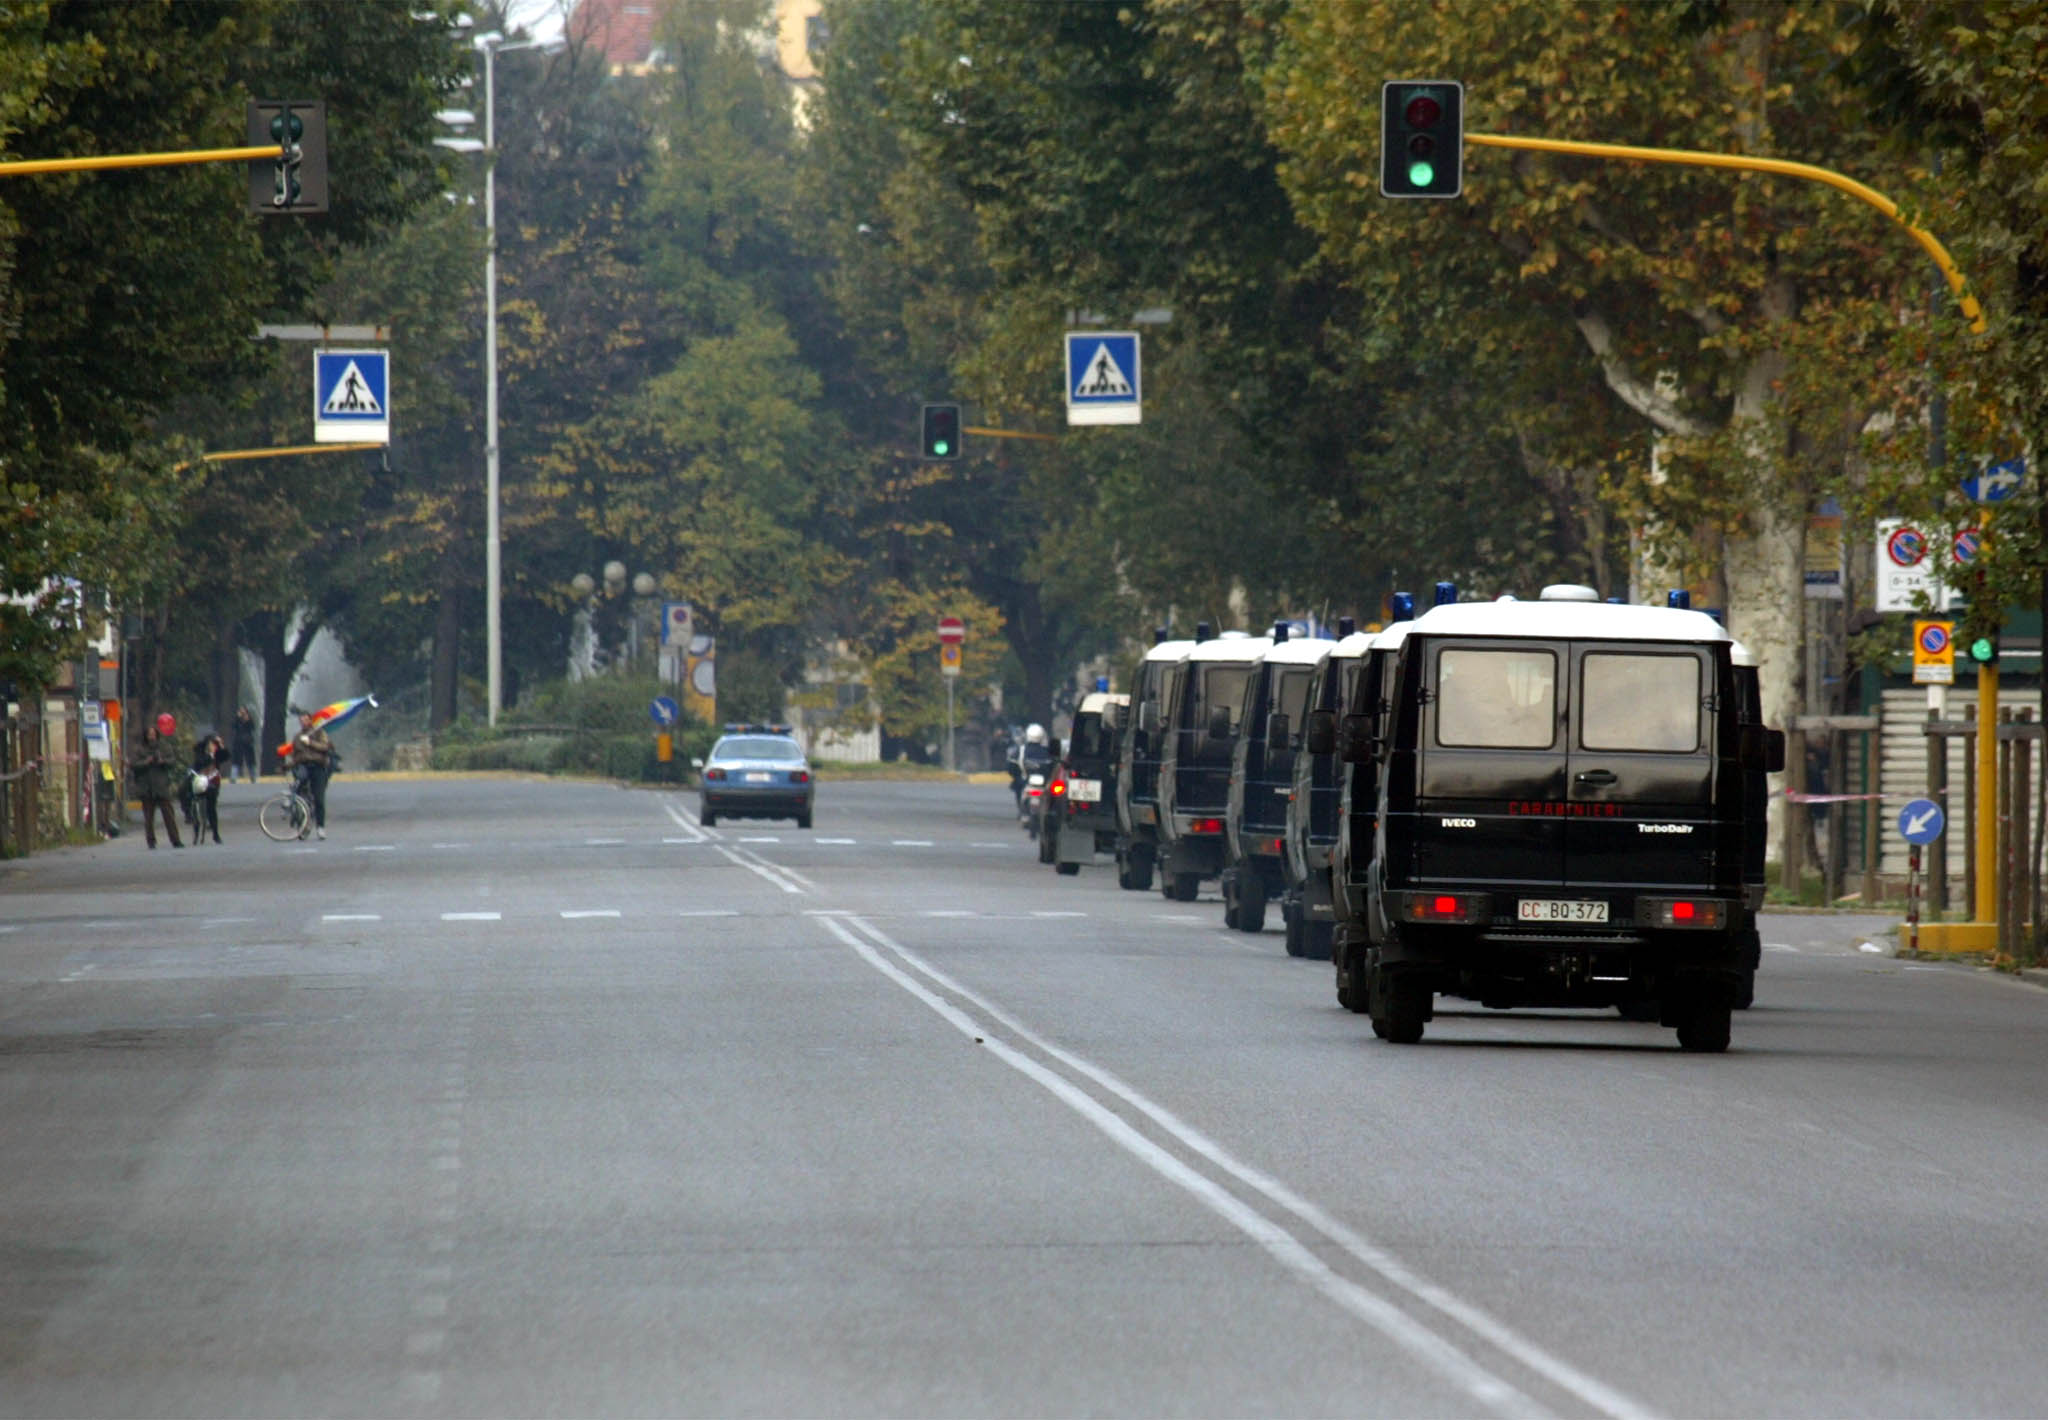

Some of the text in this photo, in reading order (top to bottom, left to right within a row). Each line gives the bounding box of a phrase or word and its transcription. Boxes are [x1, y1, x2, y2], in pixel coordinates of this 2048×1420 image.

[1442, 818, 1476, 828] IVECO
[1638, 823, 1694, 834] TurboDaily
[1521, 902, 1541, 919] CC
